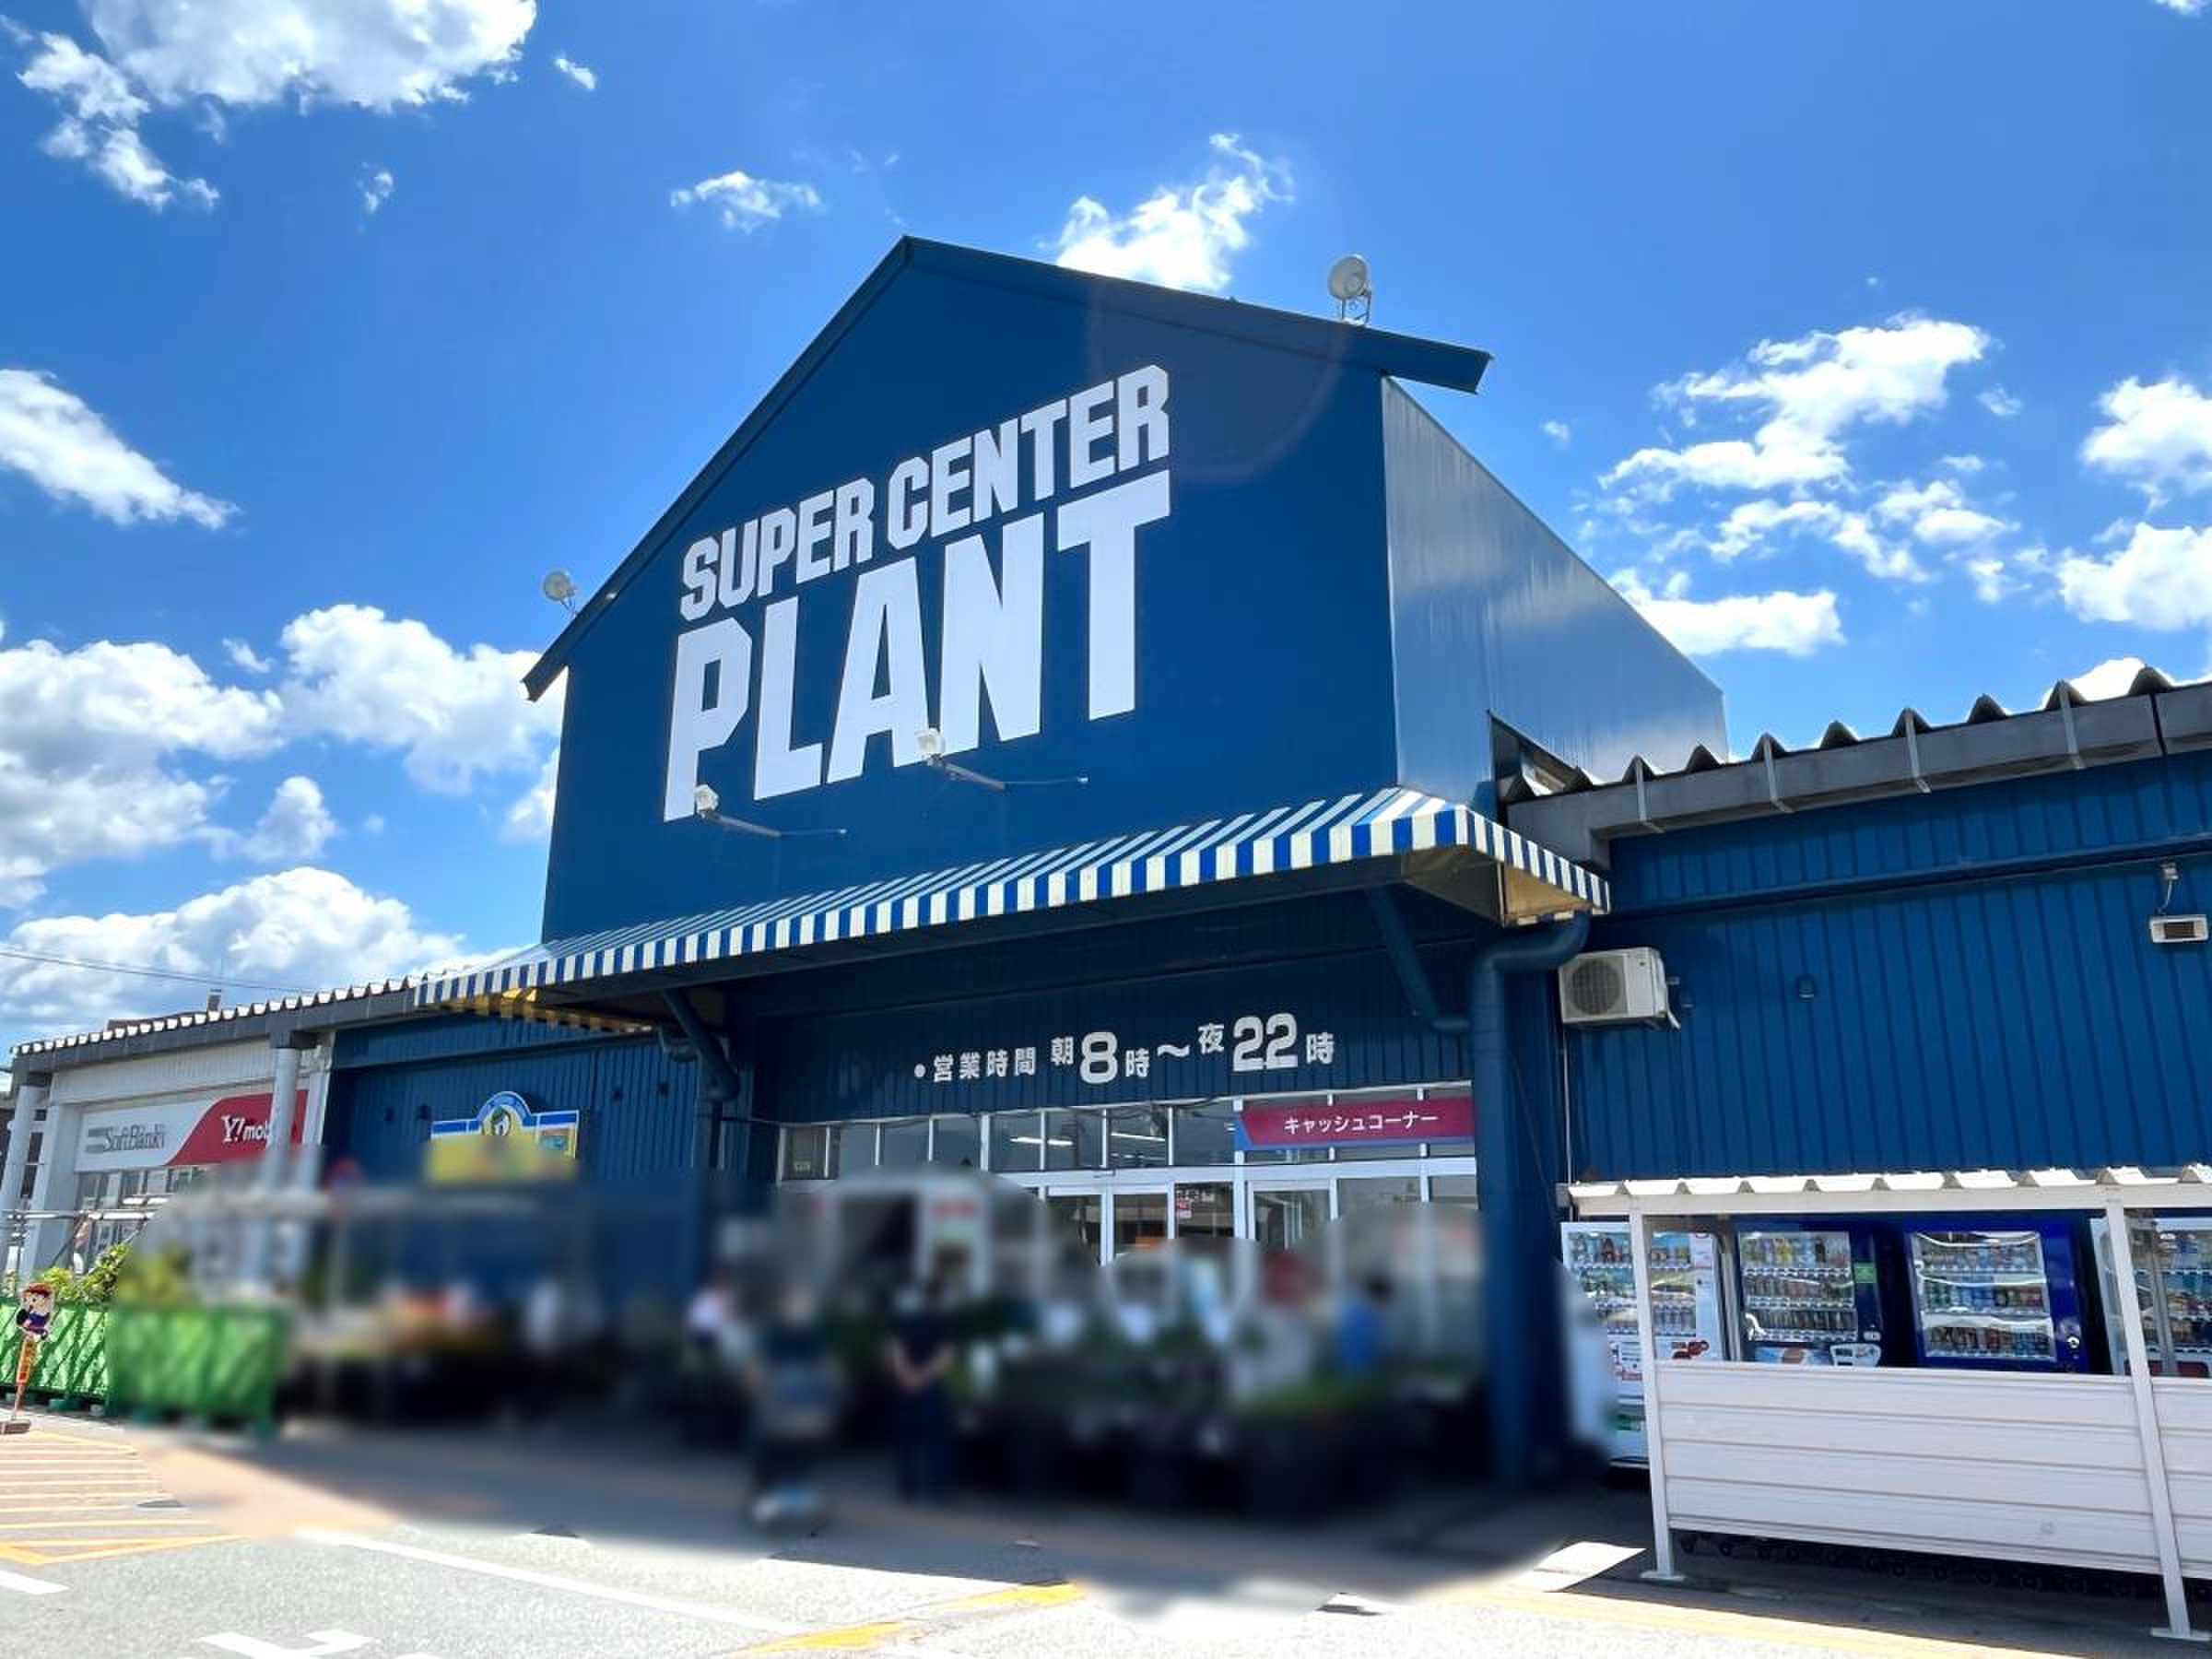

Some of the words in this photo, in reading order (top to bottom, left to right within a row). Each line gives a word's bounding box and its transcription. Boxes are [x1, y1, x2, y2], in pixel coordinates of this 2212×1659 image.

[679, 477, 875, 621] SUPER
[888, 364, 1170, 550] CENTER
[664, 469, 1171, 823] PLANT
[934, 1047, 1036, 1083] 営業時間
[103, 1124, 166, 1151] SoftBank
[1284, 1111, 1440, 1135] キャッシュコーナー
